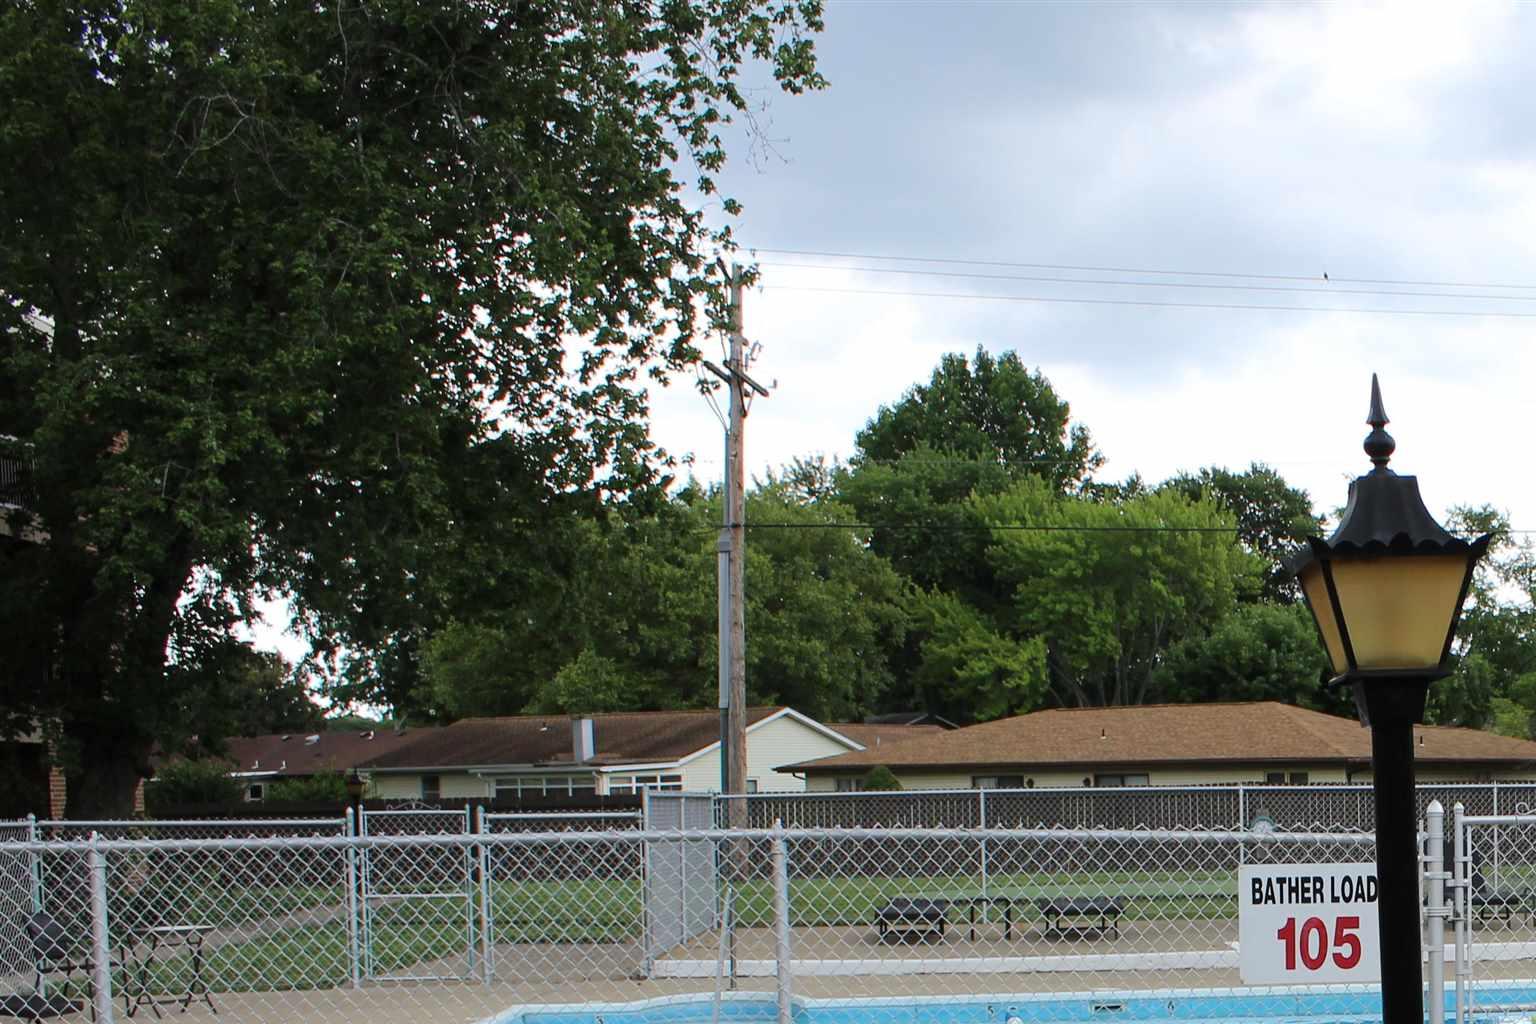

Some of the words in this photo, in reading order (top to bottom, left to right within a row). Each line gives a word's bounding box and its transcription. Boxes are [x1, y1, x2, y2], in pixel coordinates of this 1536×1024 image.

[1251, 876, 1325, 905] BATHER
[1330, 875, 1379, 903] LOAD
[1277, 916, 1362, 971] 105
